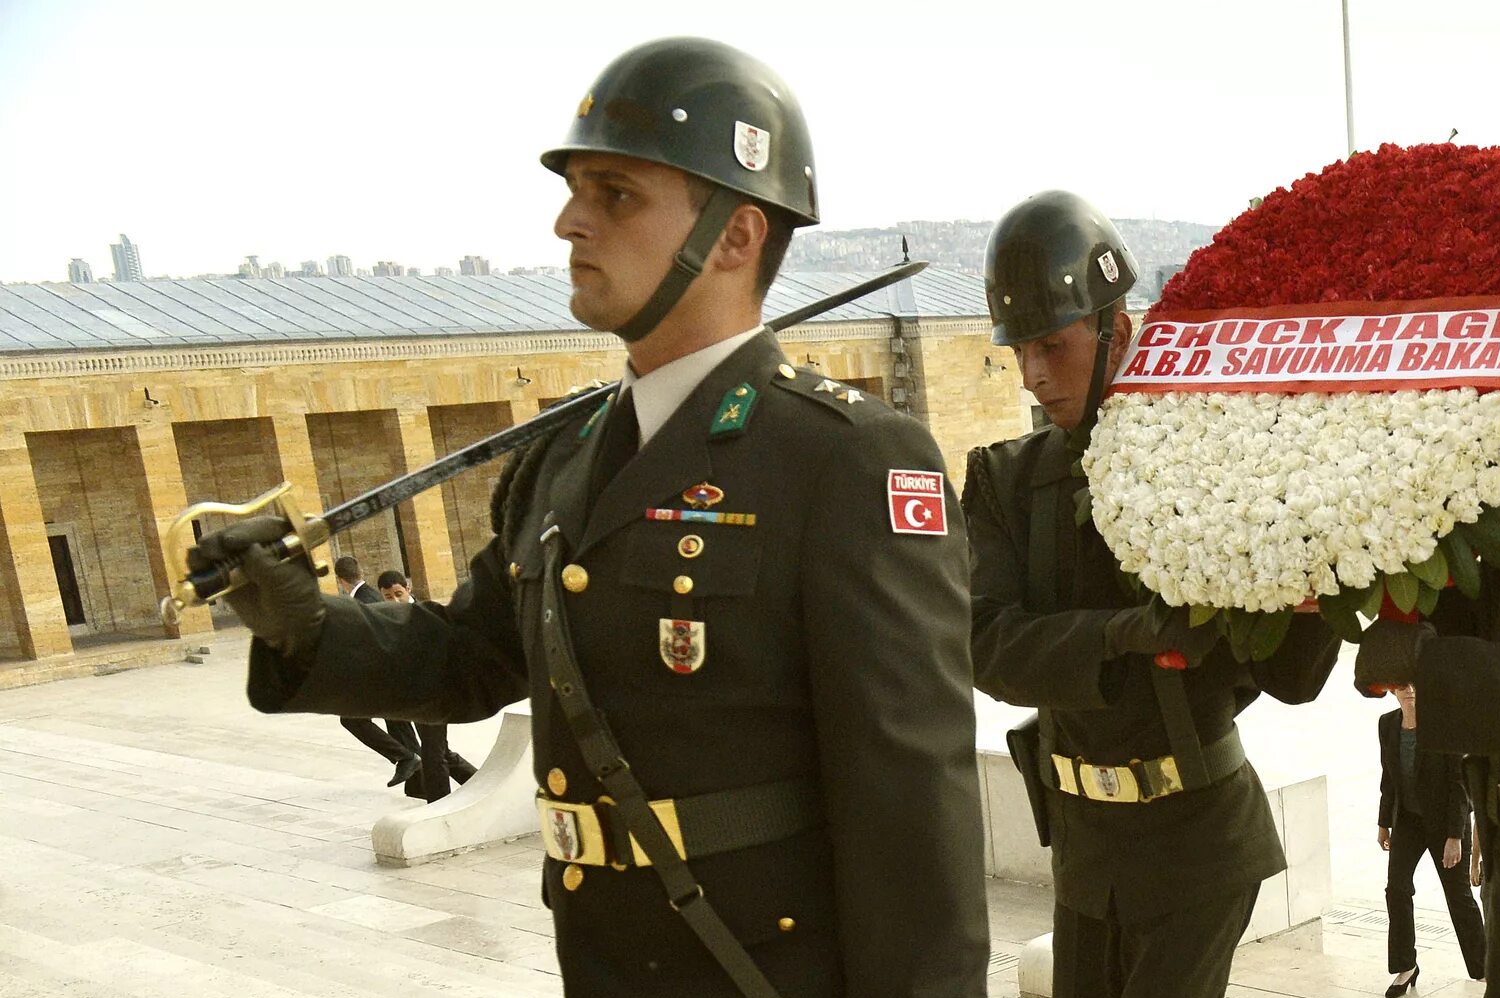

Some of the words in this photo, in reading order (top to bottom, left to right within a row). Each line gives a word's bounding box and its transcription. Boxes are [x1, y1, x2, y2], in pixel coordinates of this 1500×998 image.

[1137, 318, 1346, 349] CHUCK
[1123, 349, 1212, 376] A.B.D.
[1220, 343, 1394, 376] SAVUNMA
[894, 474, 937, 491] TÜRKİYE
